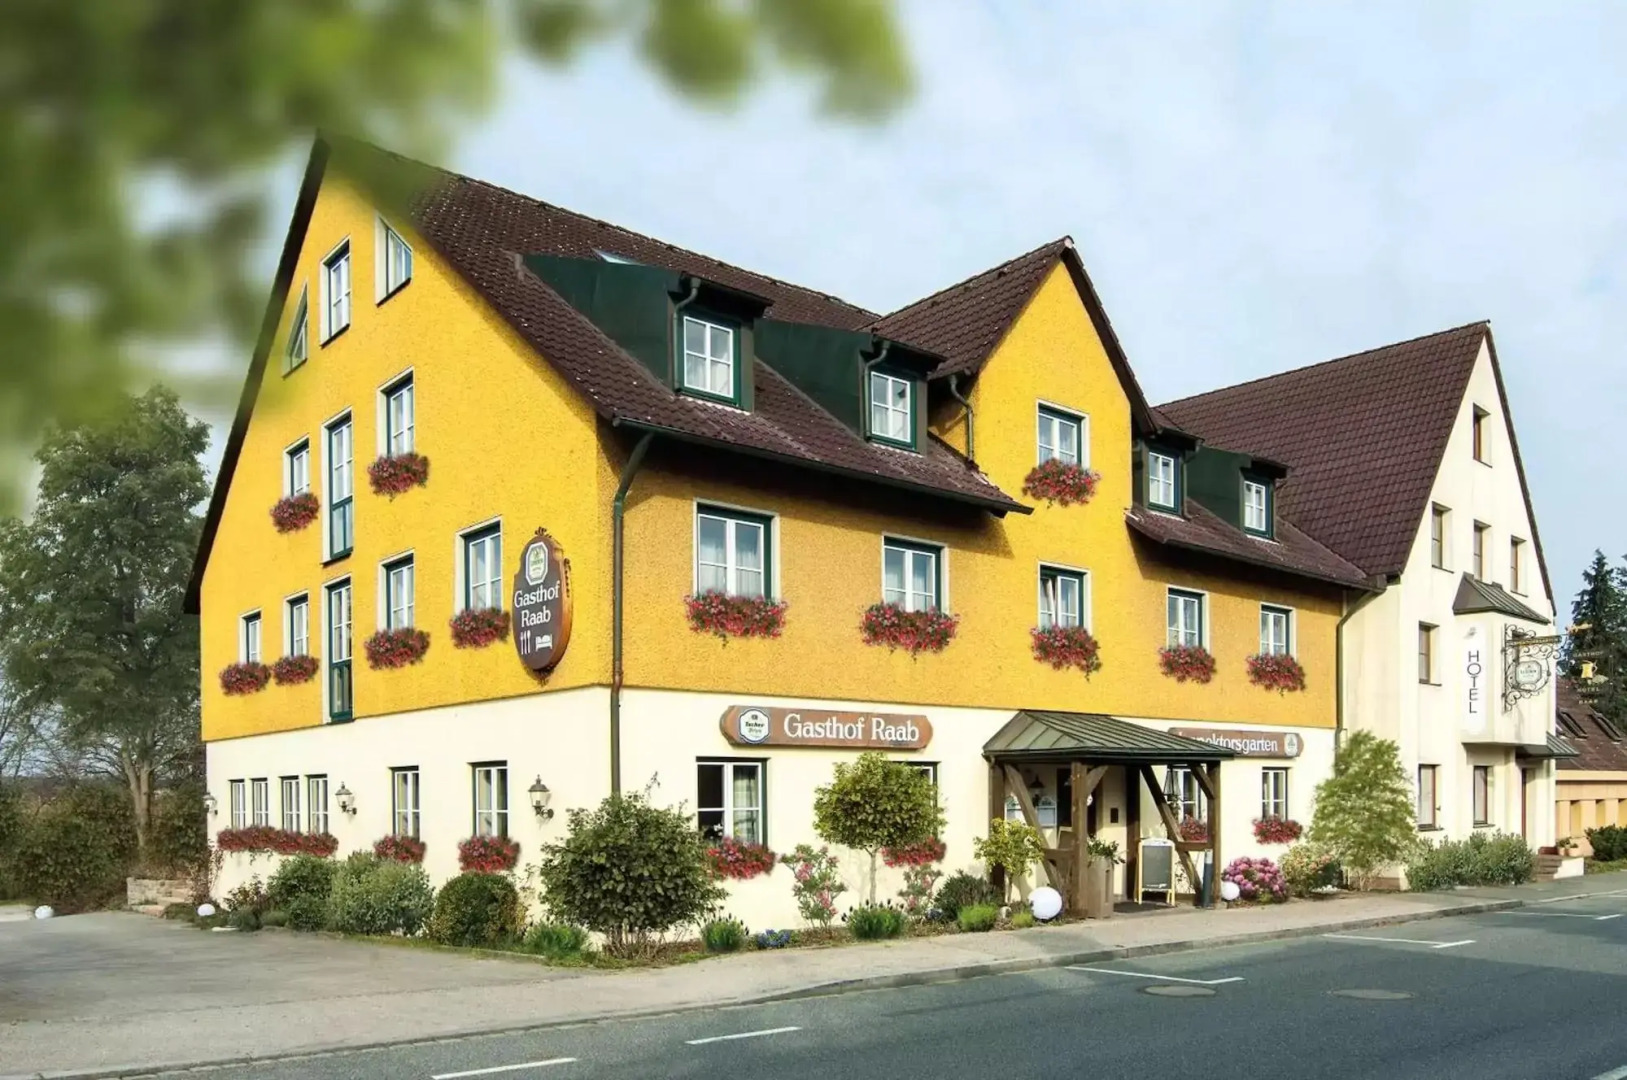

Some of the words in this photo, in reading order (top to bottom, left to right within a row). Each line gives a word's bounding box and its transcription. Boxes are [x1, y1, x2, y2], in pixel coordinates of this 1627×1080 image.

[514, 580, 561, 608] Gasthof
[521, 606, 552, 628] Raab
[1467, 650, 1482, 714] HOTEL
[783, 713, 865, 740] Gasthof
[871, 717, 920, 742] Raab
[1178, 731, 1278, 754] ktorsgarten
